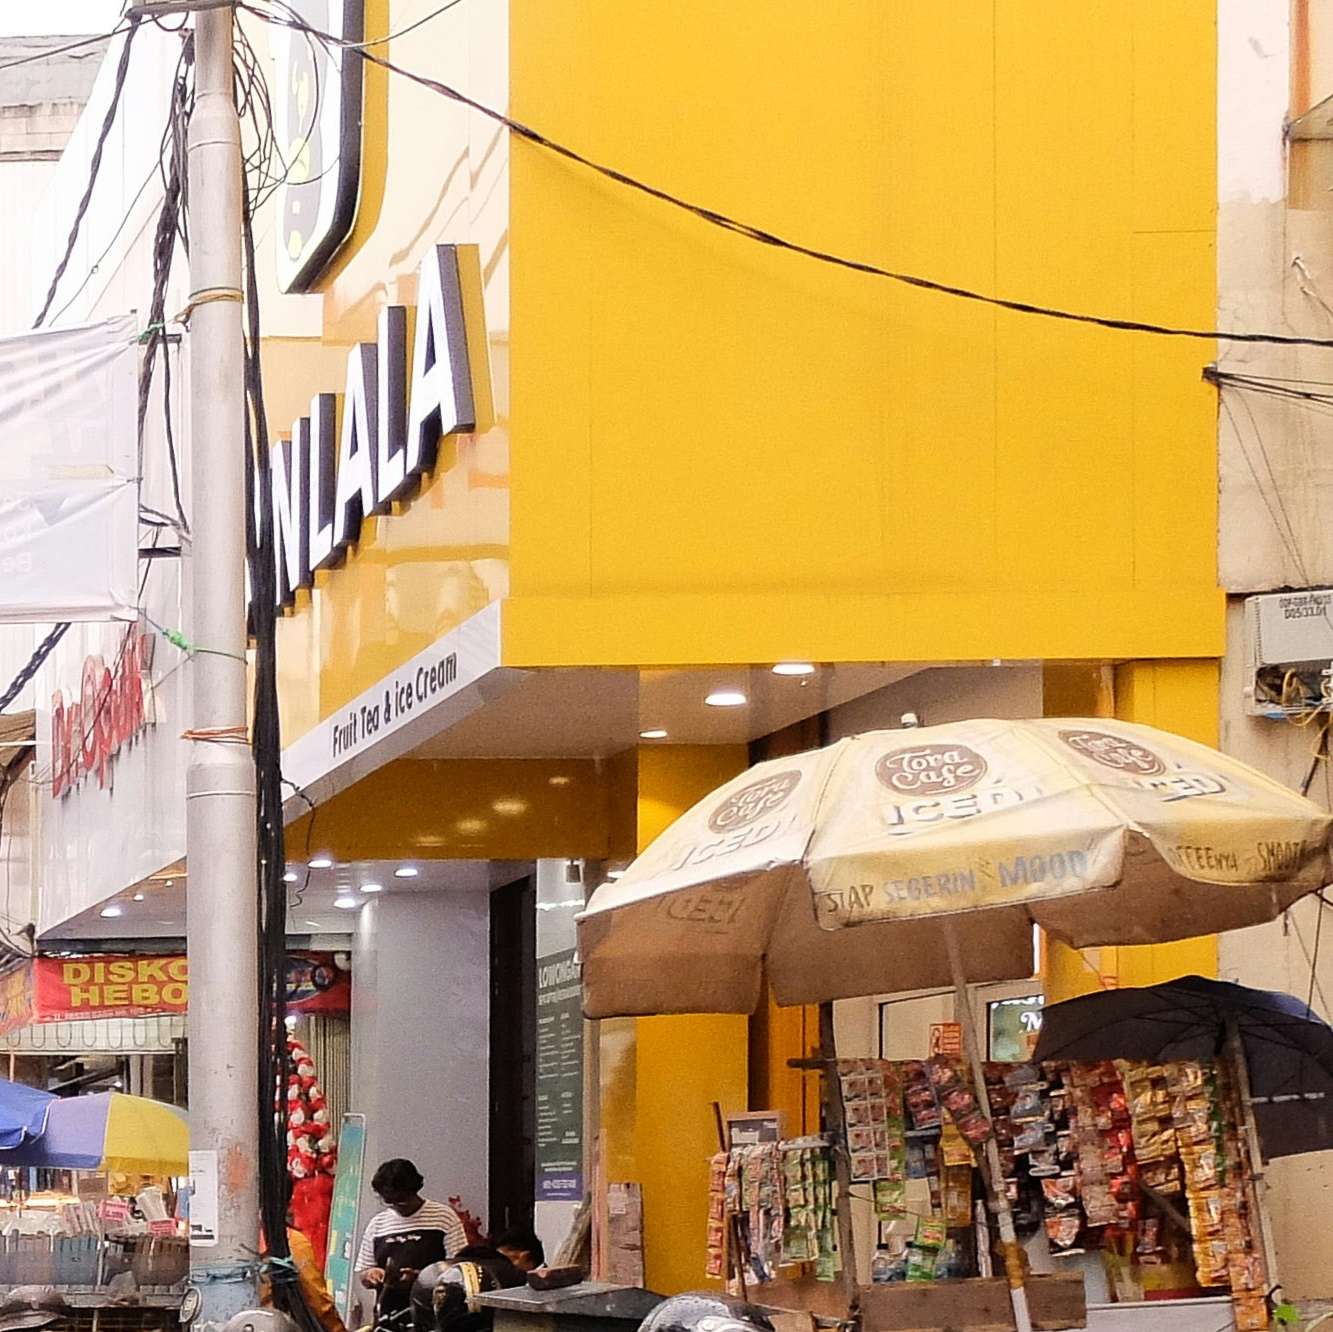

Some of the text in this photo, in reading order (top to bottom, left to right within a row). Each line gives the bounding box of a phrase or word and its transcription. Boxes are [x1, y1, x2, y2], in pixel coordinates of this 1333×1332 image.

[249, 243, 475, 632] NLALA
[333, 712, 357, 758] Fruit
[360, 704, 380, 740] Tea
[416, 652, 458, 703] Cream
[886, 747, 968, 772] Tora
[891, 762, 980, 789] Cafe
[998, 849, 1087, 888] MOOD
